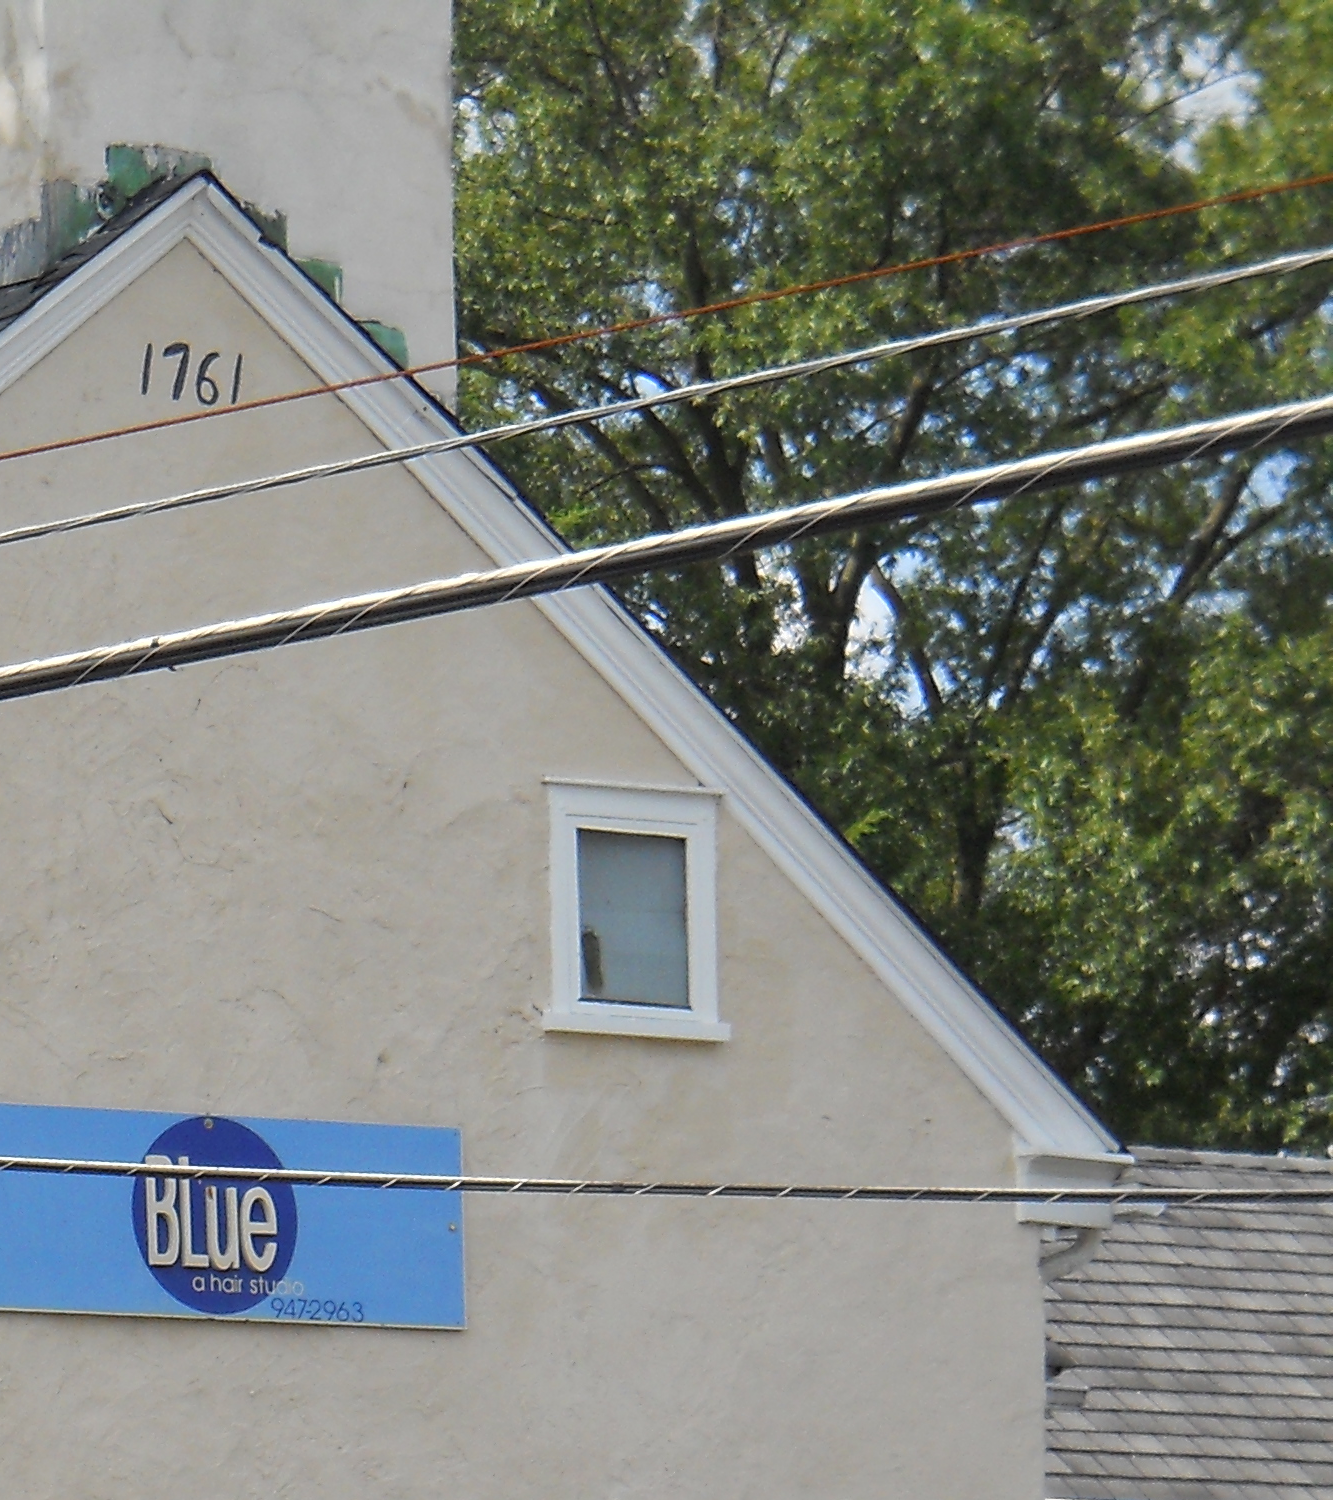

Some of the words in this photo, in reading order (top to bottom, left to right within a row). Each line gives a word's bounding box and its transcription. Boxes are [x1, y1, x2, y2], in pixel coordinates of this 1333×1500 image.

[140, 342, 244, 406] 1761
[191, 1275, 206, 1293] a
[209, 1273, 243, 1295] hair
[249, 1276, 305, 1297] studio
[270, 1297, 365, 1323] 947-2963
